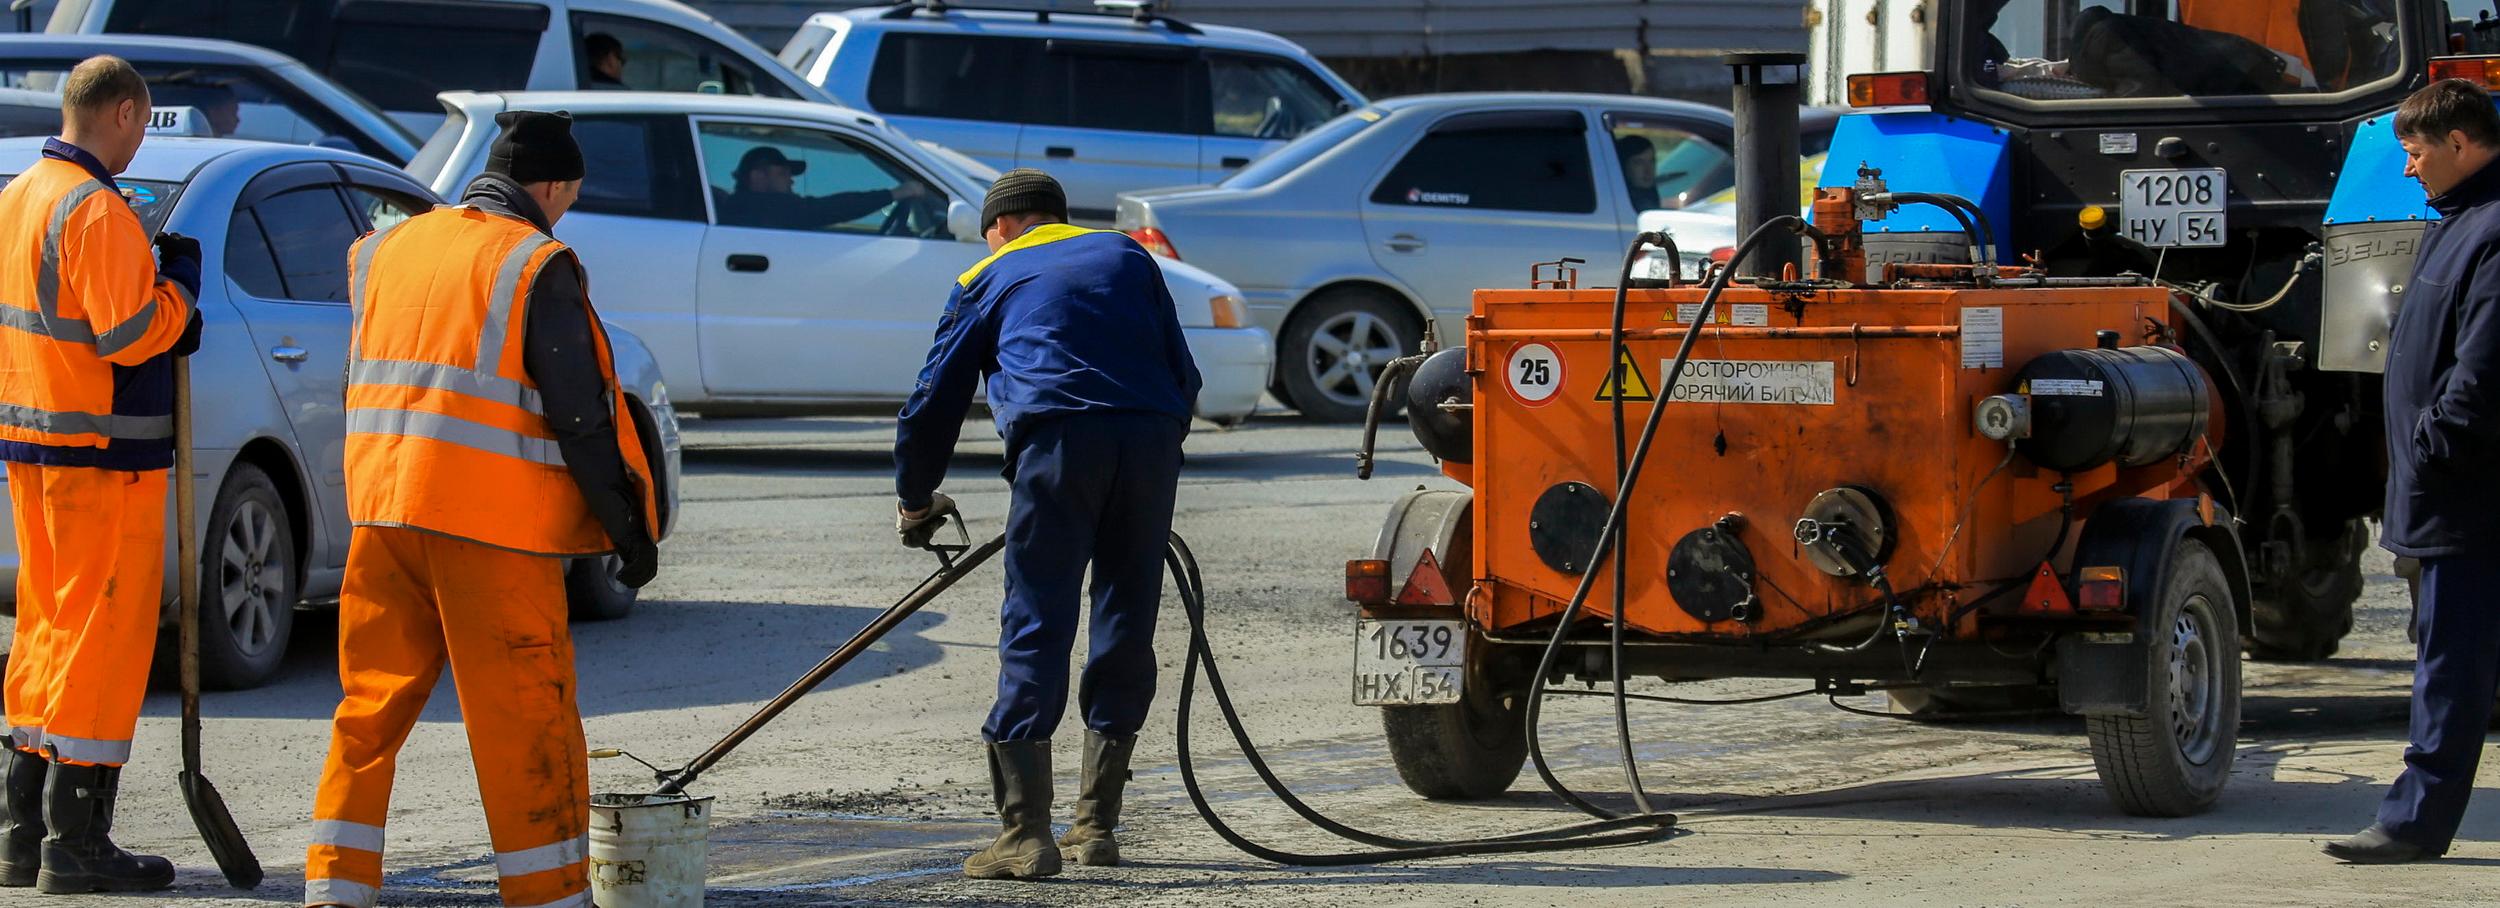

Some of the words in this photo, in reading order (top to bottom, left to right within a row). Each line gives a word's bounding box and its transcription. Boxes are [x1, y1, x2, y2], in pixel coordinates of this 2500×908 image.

[2137, 175, 2213, 206] 1208
[2130, 218, 2166, 242] НУ
[2187, 218, 2217, 241] 54
[2329, 238, 2419, 267] BELA
[1520, 358, 1549, 385] 25
[1673, 382, 1754, 401] ОРЯЧИЙ
[1370, 625, 1452, 660] 1639
[1361, 671, 1403, 700] НХ
[1420, 672, 1453, 699] 54
